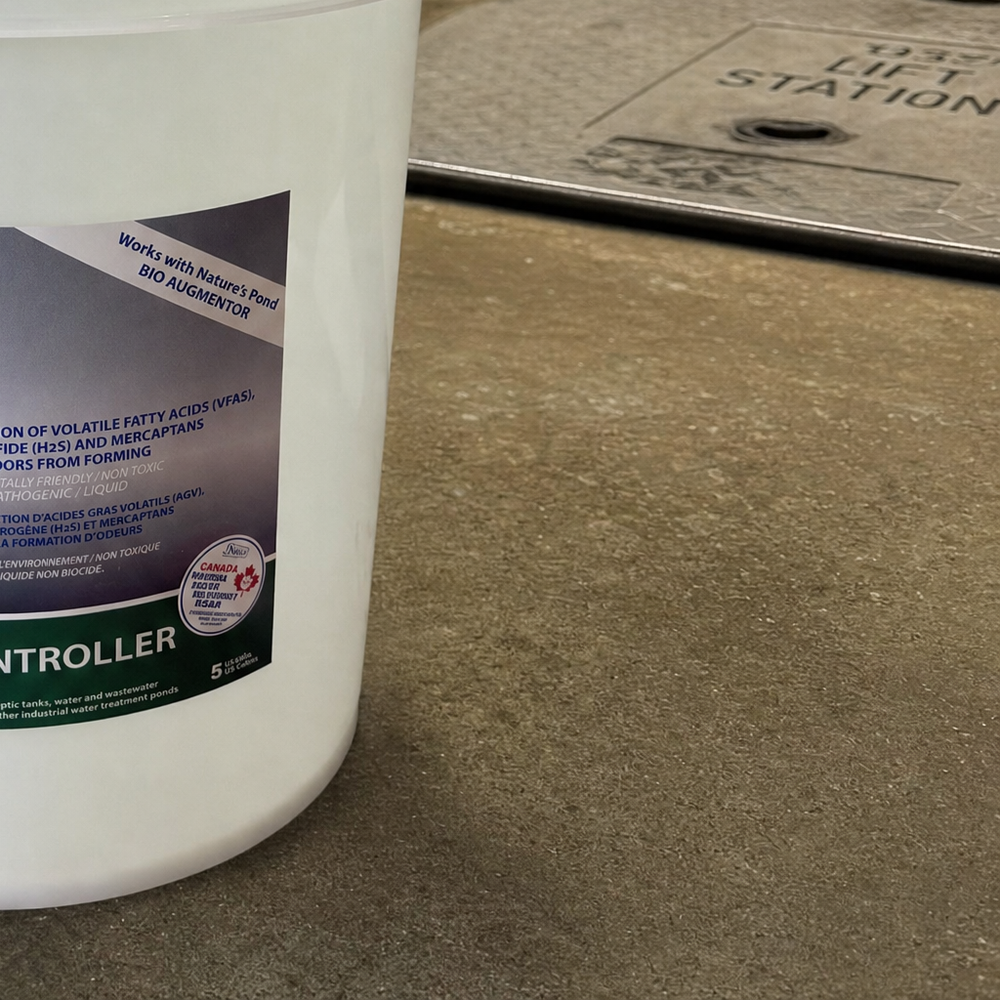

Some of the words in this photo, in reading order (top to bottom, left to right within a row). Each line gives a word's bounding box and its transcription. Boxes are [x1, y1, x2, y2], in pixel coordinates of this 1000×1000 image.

[824, 55, 978, 85] LIFT
[715, 67, 1000, 116] STATION
[118, 231, 163, 262] Works
[164, 255, 195, 277] with
[196, 267, 248, 298] Nature's
[248, 288, 280, 311] Pond
[138, 263, 166, 284] BIO
[165, 276, 251, 320] AUGMENTOR
[27, 425, 48, 438] OF
[51, 418, 120, 437] VOLATILE
[124, 410, 166, 428] FATTY
[169, 401, 209, 420] ACIDS
[212, 389, 256, 412] (VFAS),
[32, 440, 71, 455] (H2S)
[74, 436, 107, 451] AND
[110, 418, 205, 447] MERCAPTANS
[37, 456, 82, 471] FROM
[84, 445, 152, 467] FORMING
[131, 460, 165, 475] TOXIC
[83, 480, 128, 497] LIQUID
[33, 509, 85, 523] D'ACIDES
[88, 505, 118, 518] GRAS
[120, 495, 171, 513] VOLATILS
[83, 520, 97, 531] ET
[99, 505, 175, 528] MERCAPTANS
[12, 534, 82, 548] FORMATION
[84, 525, 143, 542] D'ODEURS
[119, 541, 161, 558] TOXIQUE
[36, 570, 60, 579] NON
[200, 562, 238, 573] CANADA
[211, 662, 223, 680] 5
[21, 698, 52, 708] tanks,
[54, 696, 83, 706] water
[84, 691, 103, 702] and
[104, 681, 159, 699] wastewater
[21, 704, 69, 719] industrial
[70, 704, 99, 715] water
[100, 694, 148, 710] treatment
[150, 686, 179, 701] ponds
